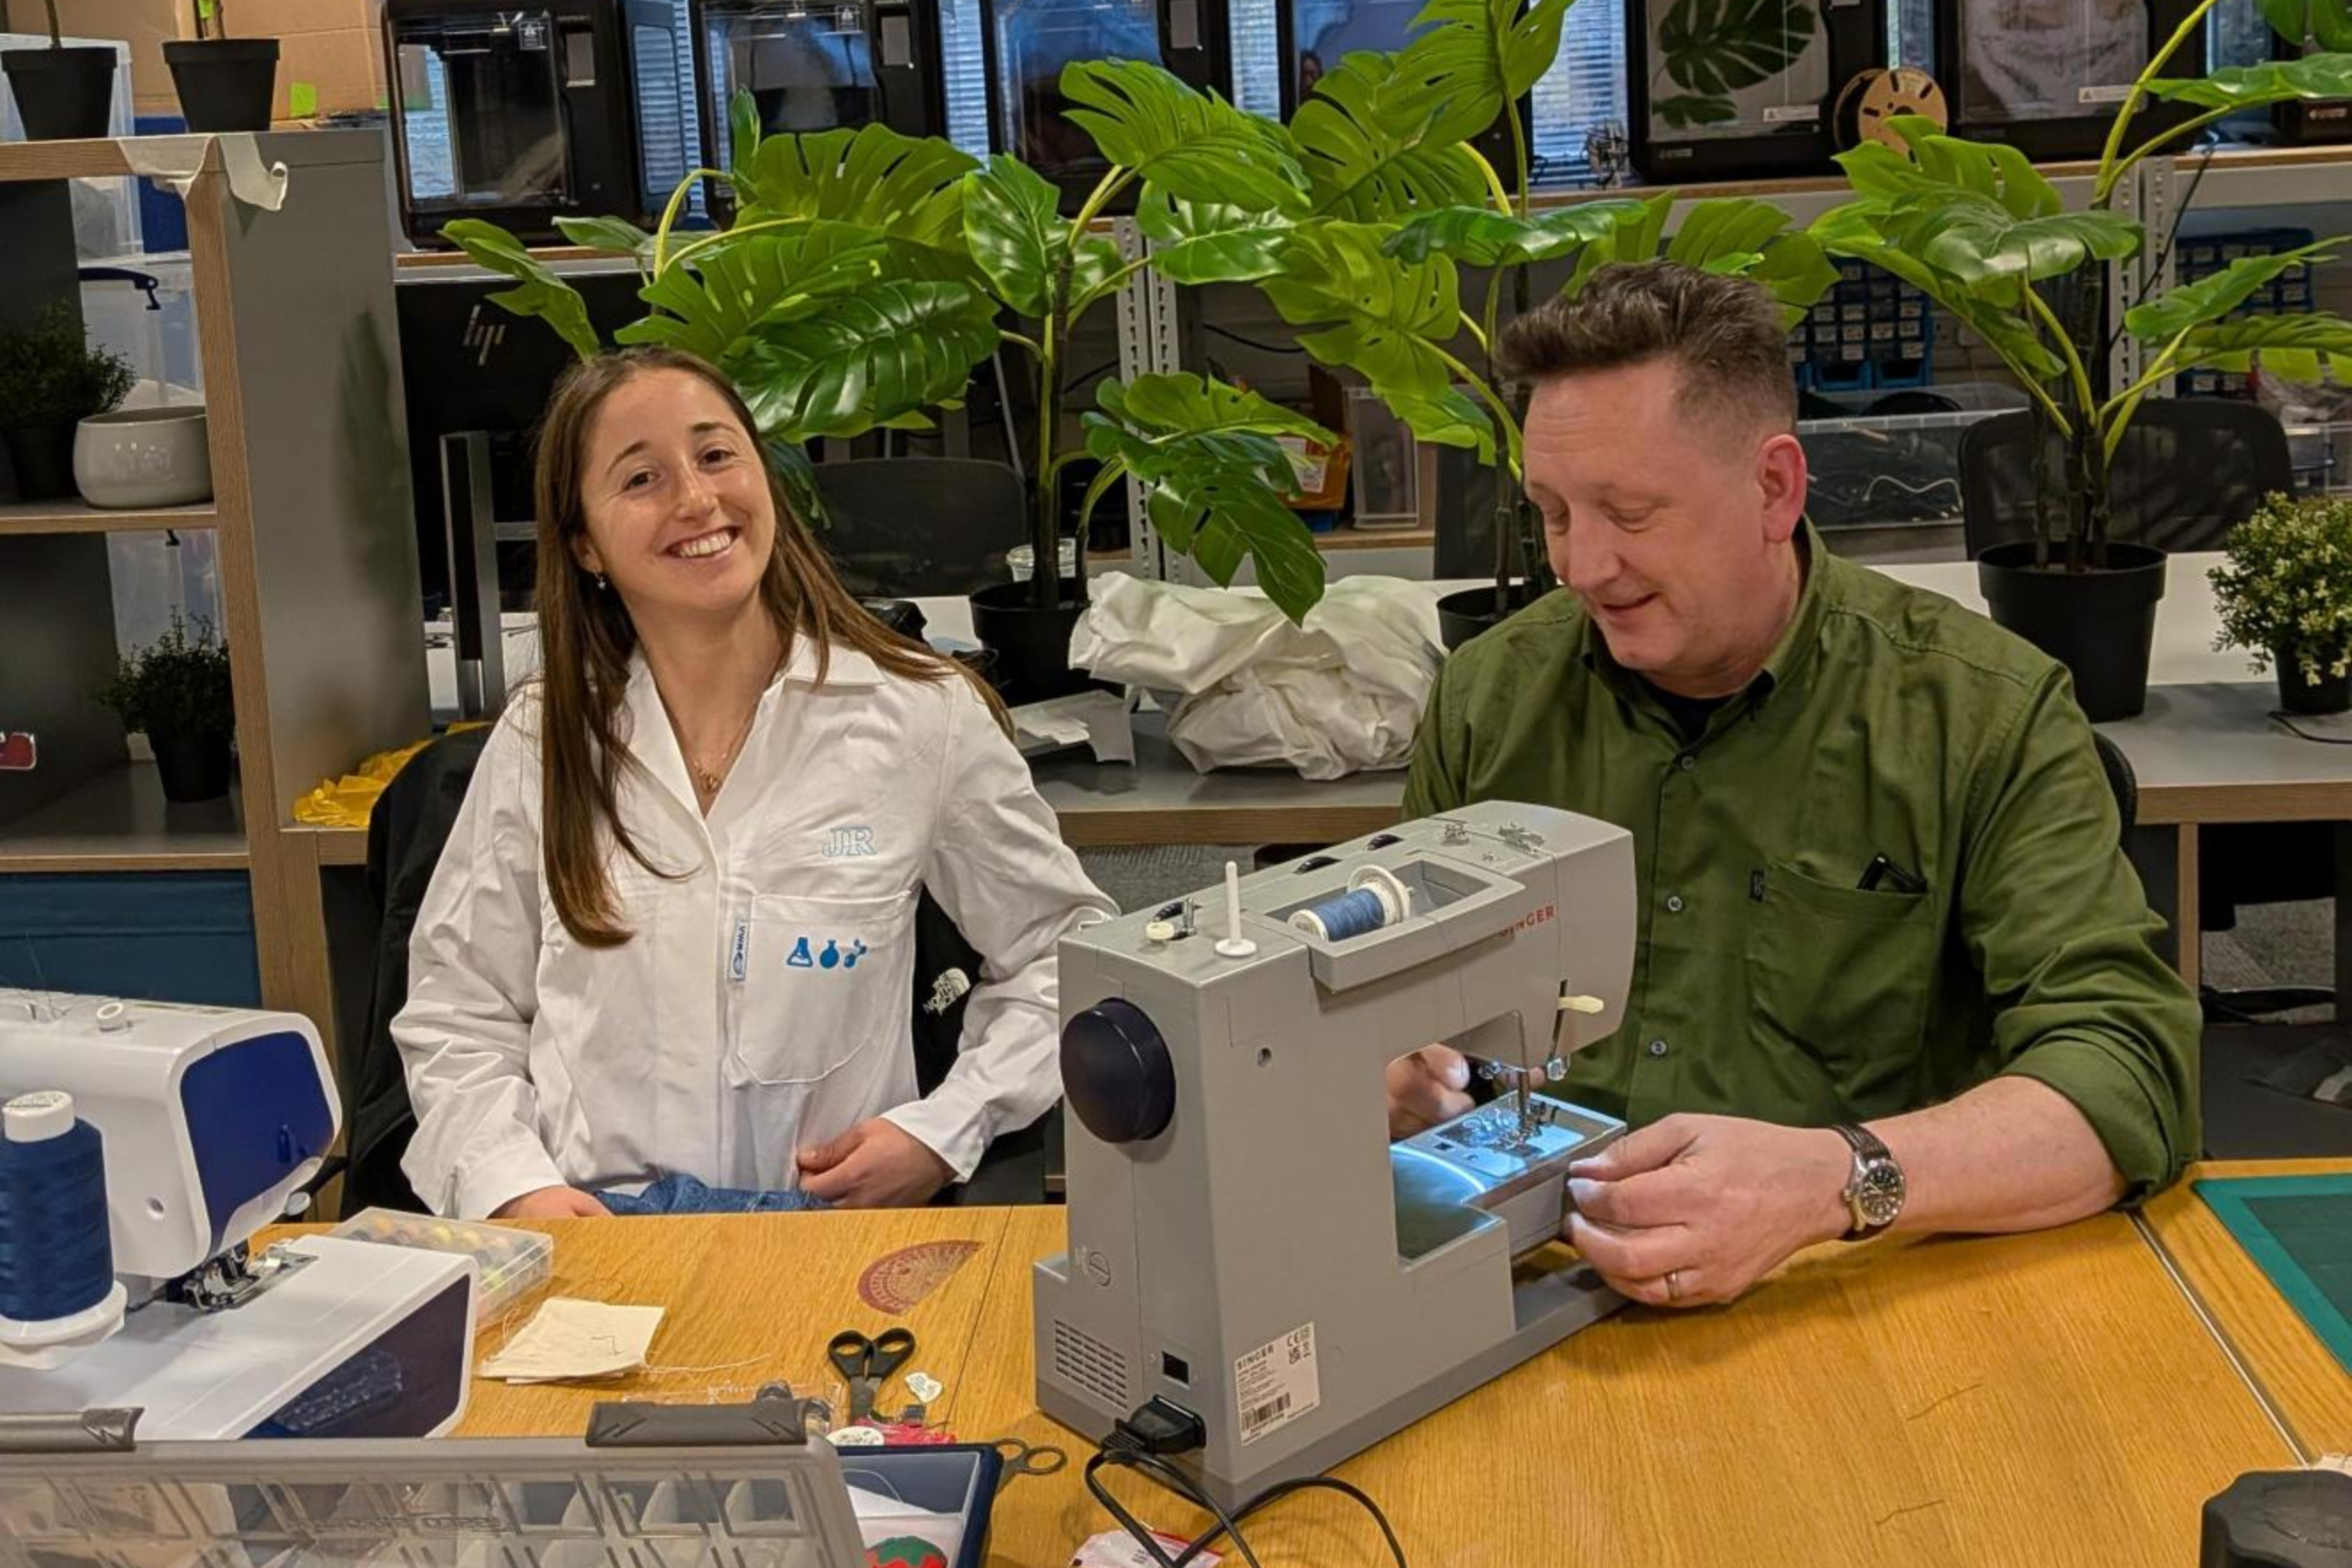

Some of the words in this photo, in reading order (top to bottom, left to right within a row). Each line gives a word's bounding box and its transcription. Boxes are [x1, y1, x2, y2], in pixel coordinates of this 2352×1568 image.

[463, 304, 506, 366] hp
[822, 826, 877, 857] JR
[1236, 1345, 1274, 1370] SINGER
